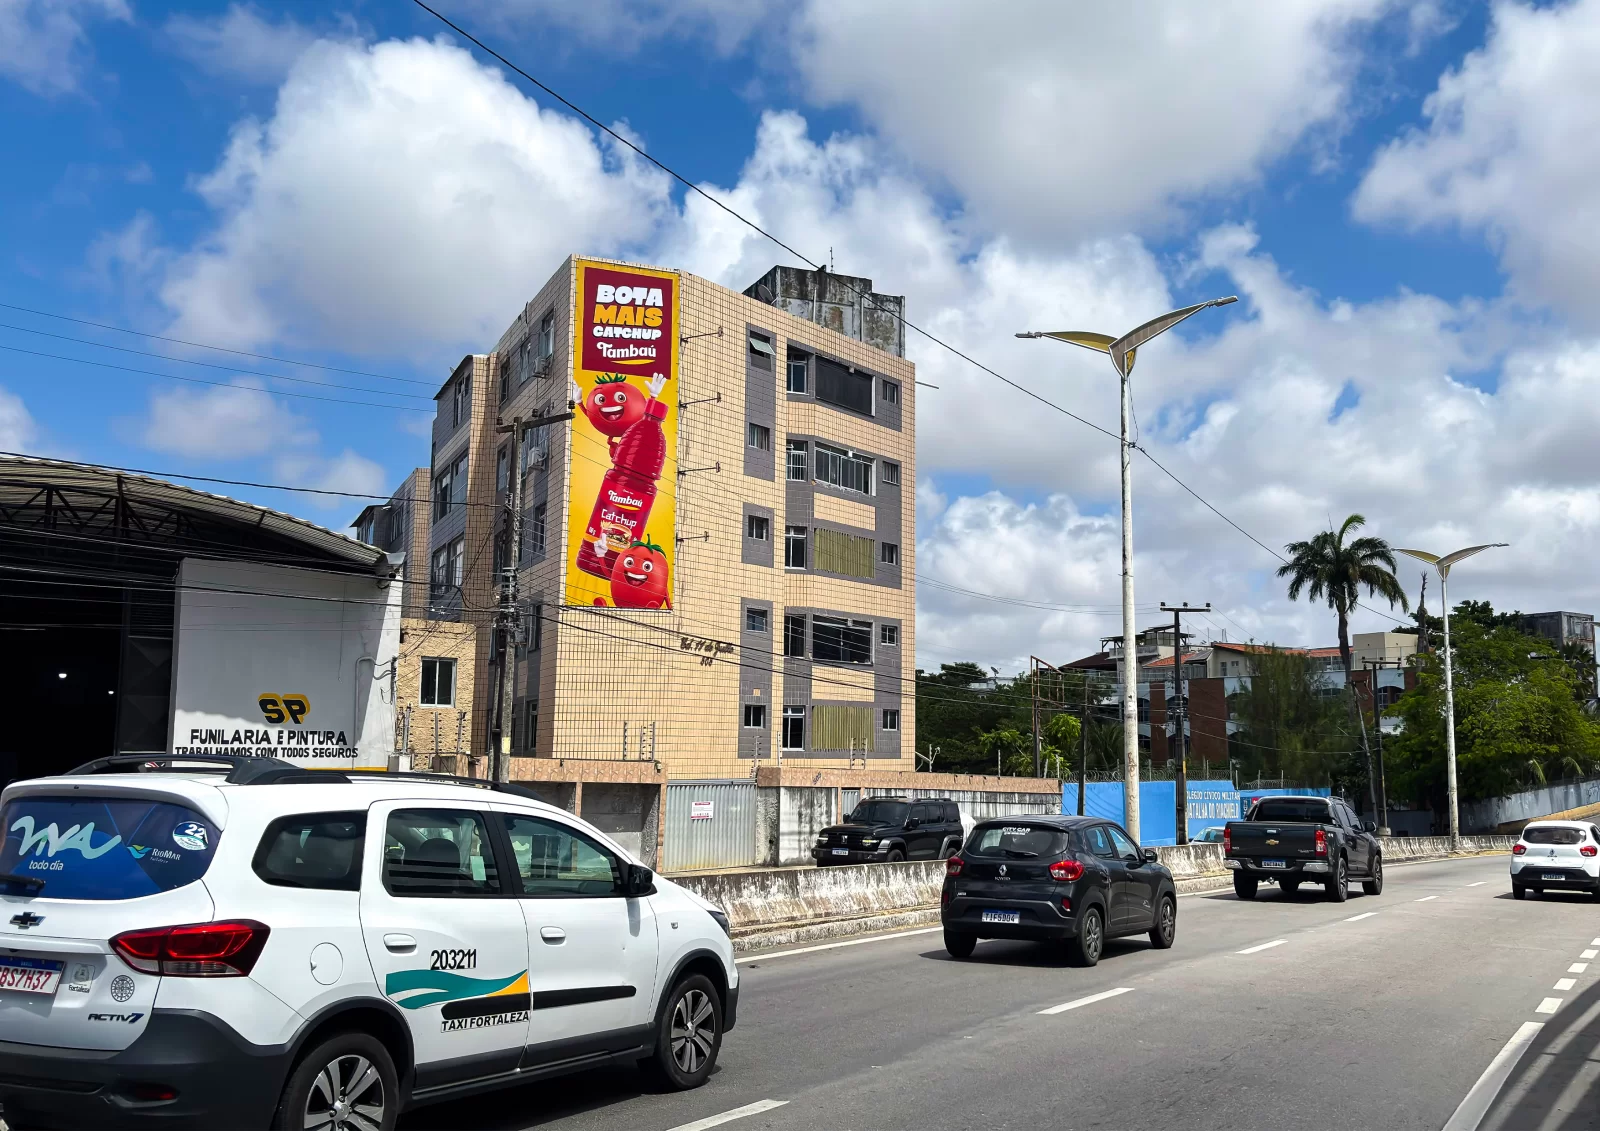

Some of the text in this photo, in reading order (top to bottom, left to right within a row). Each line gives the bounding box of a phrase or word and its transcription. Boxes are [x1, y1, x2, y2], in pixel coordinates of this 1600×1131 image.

[596, 285, 664, 307] BOTA
[593, 304, 663, 327] MAIS
[593, 326, 662, 340] CATCHUP
[596, 342, 657, 358] Tambaú
[608, 490, 643, 507] Tambaú
[601, 508, 637, 530] Catchup
[258, 693, 310, 724] SP
[190, 729, 347, 745] FUNILARIA E PINTURA
[255, 747, 278, 758] COM
[281, 748, 310, 758] TODOS
[312, 748, 359, 758] SEGUROS
[1222, 790, 1240, 800] MILITAR
[1187, 803, 1208, 819] ATALHA
[28, 860, 49, 870] todo
[430, 949, 477, 969] 203211
[0, 967, 53, 991] BS7H37
[441, 1010, 530, 1031] TAXI FORTALEZA
